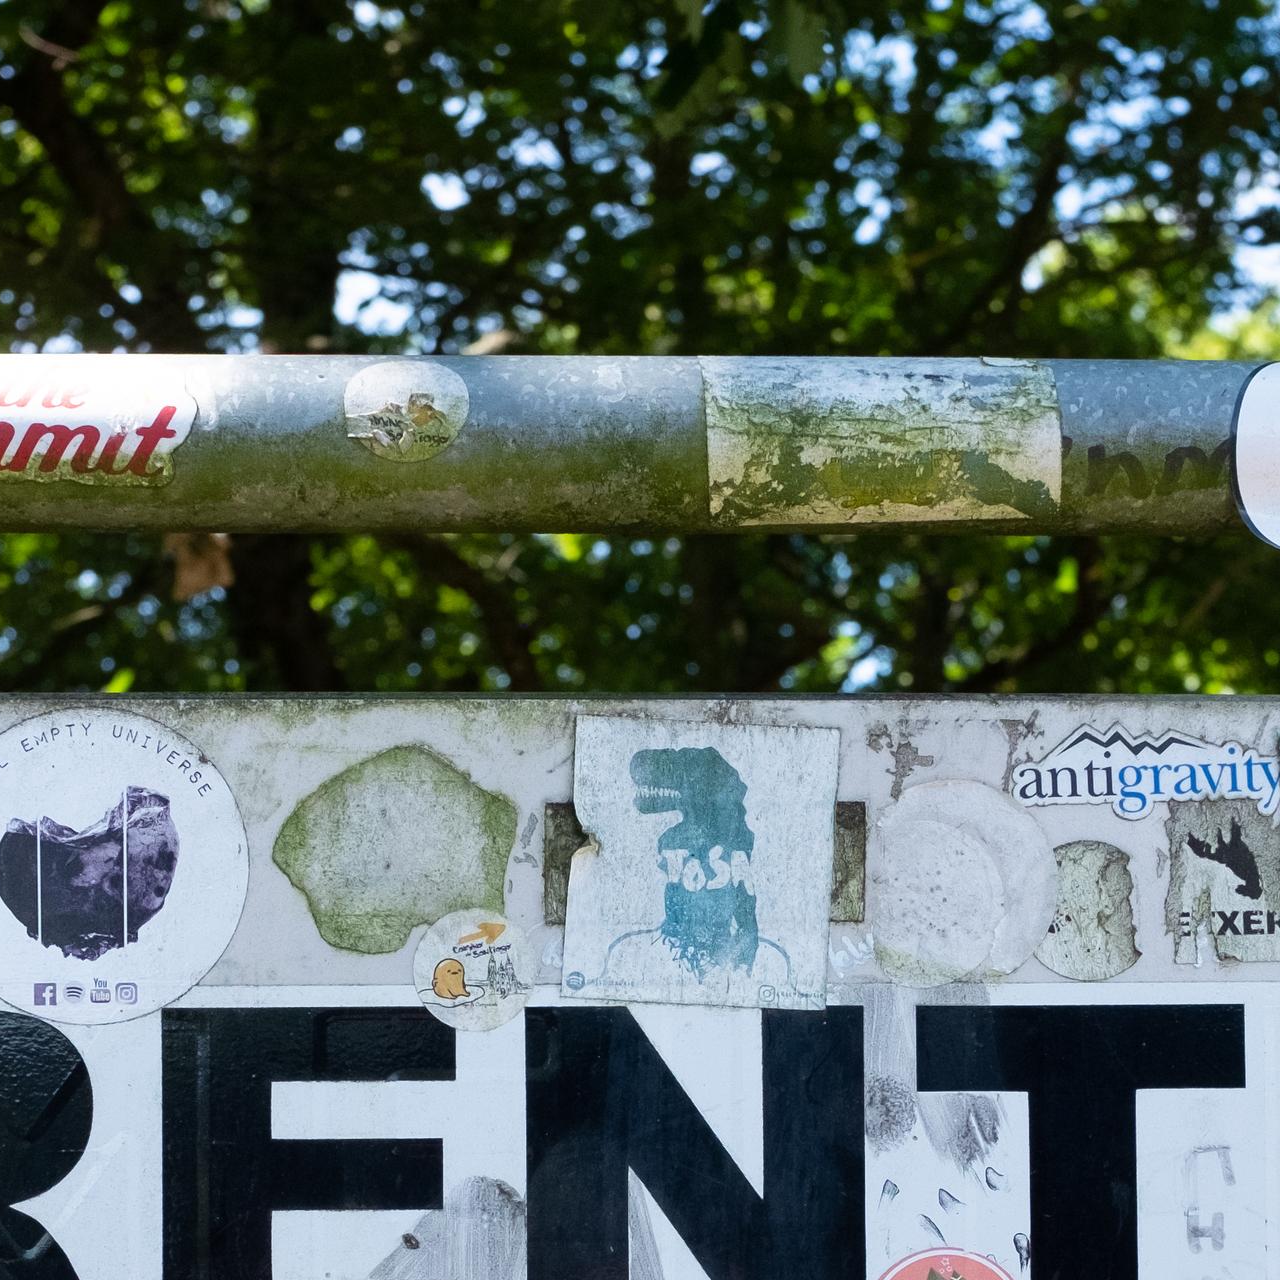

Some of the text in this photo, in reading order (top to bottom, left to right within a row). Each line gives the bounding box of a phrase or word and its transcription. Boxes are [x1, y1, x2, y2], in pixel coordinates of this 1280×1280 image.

[20, 723, 92, 753] EMPTY
[112, 724, 212, 797] UNIVERSE
[1019, 747, 1280, 813] antigravity
